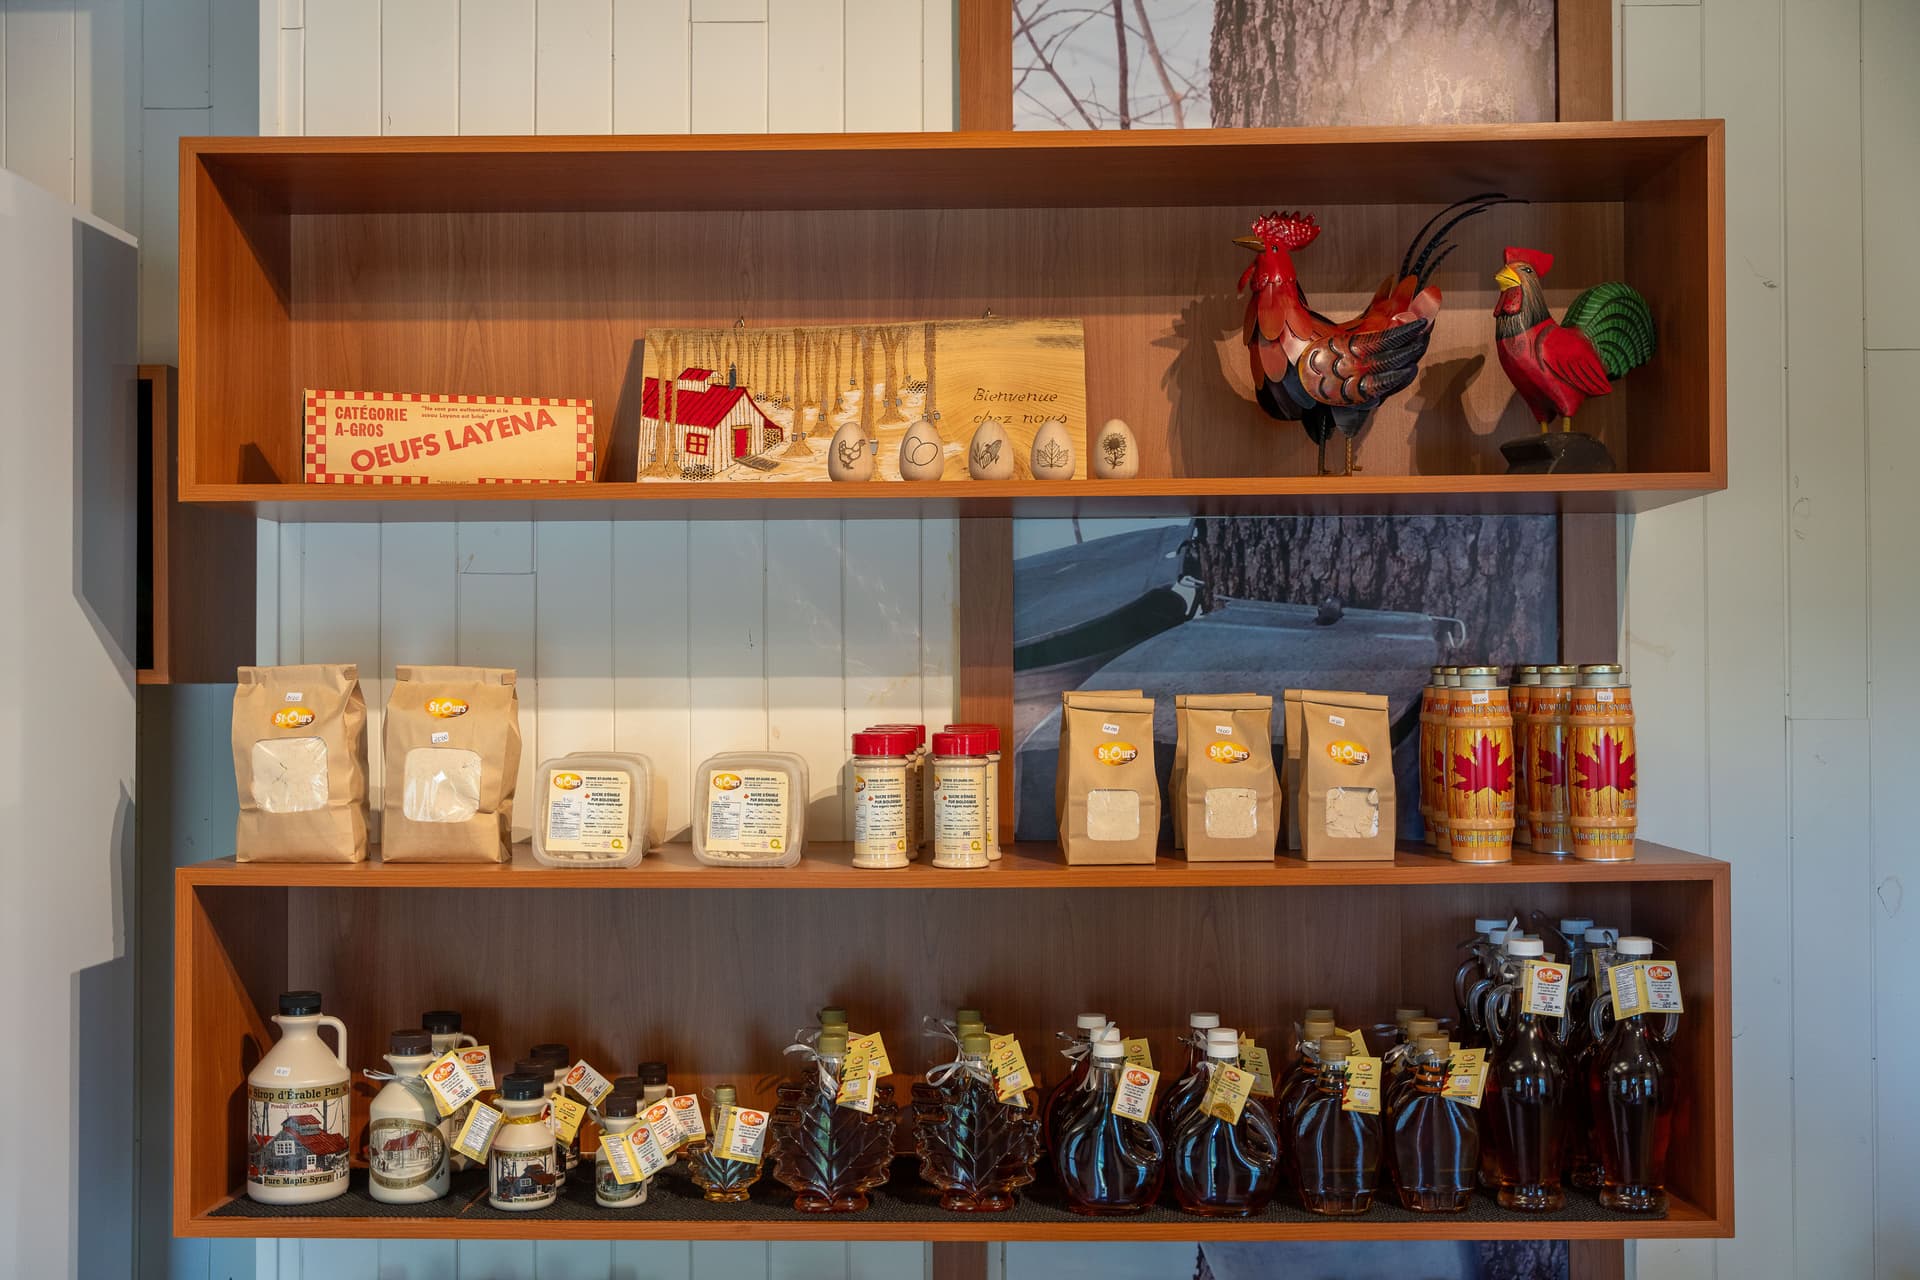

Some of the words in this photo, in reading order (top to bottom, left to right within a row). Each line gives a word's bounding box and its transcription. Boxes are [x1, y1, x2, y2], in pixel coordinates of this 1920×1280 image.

[973, 387, 1058, 402] Bienvenue
[335, 405, 408, 421] CATÉGORIE
[335, 422, 384, 437] A-GROS
[351, 433, 441, 472] OEUFS
[445, 408, 558, 451] LAYENA
[253, 1088, 275, 1100] Sirop
[278, 1088, 322, 1100] d'Érable
[325, 1087, 339, 1097] Pur
[263, 1176, 280, 1185] Pure
[282, 1176, 308, 1186] Maple
[309, 1174, 332, 1184] Syrup
